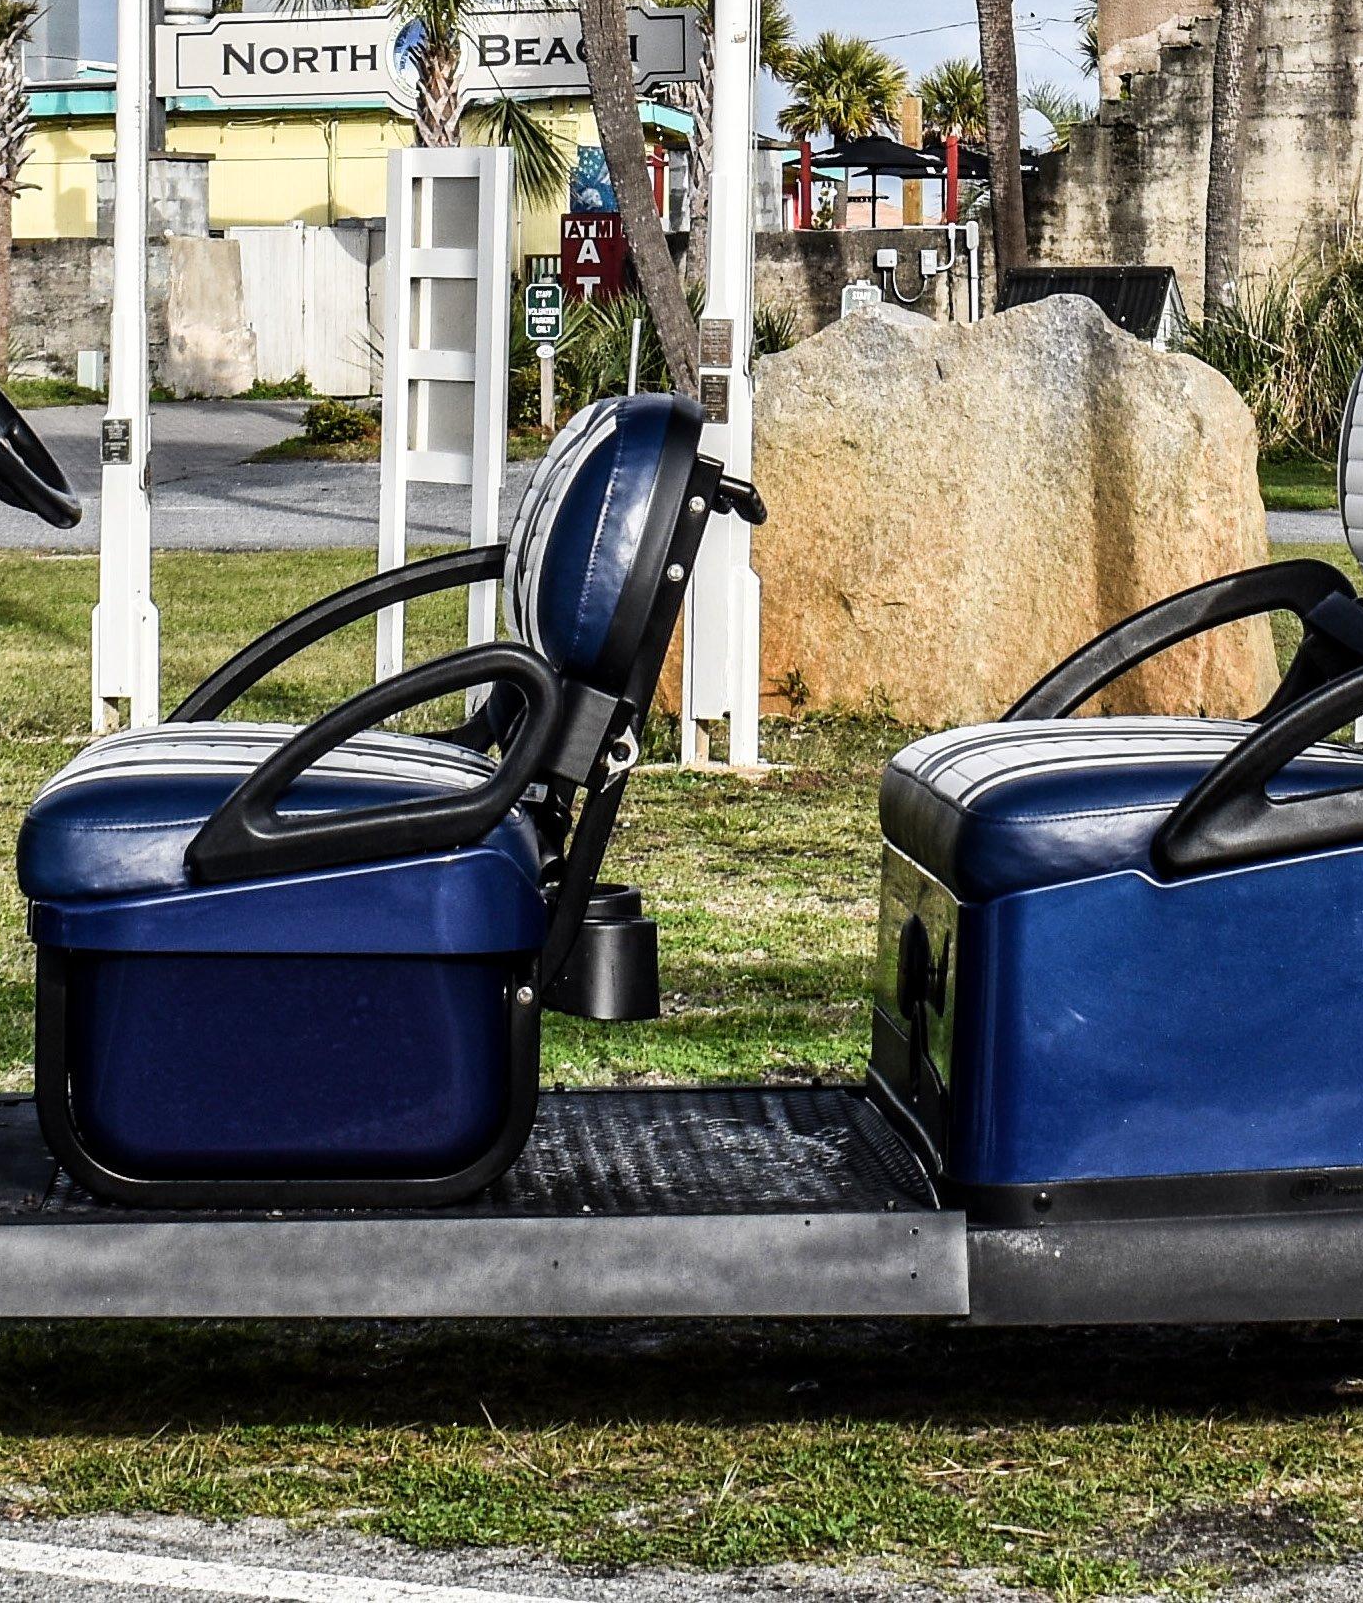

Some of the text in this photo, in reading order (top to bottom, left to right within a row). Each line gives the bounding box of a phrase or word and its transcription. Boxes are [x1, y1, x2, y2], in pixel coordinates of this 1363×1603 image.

[223, 34, 639, 75] NORTH BEA
[567, 221, 611, 238] ATM
